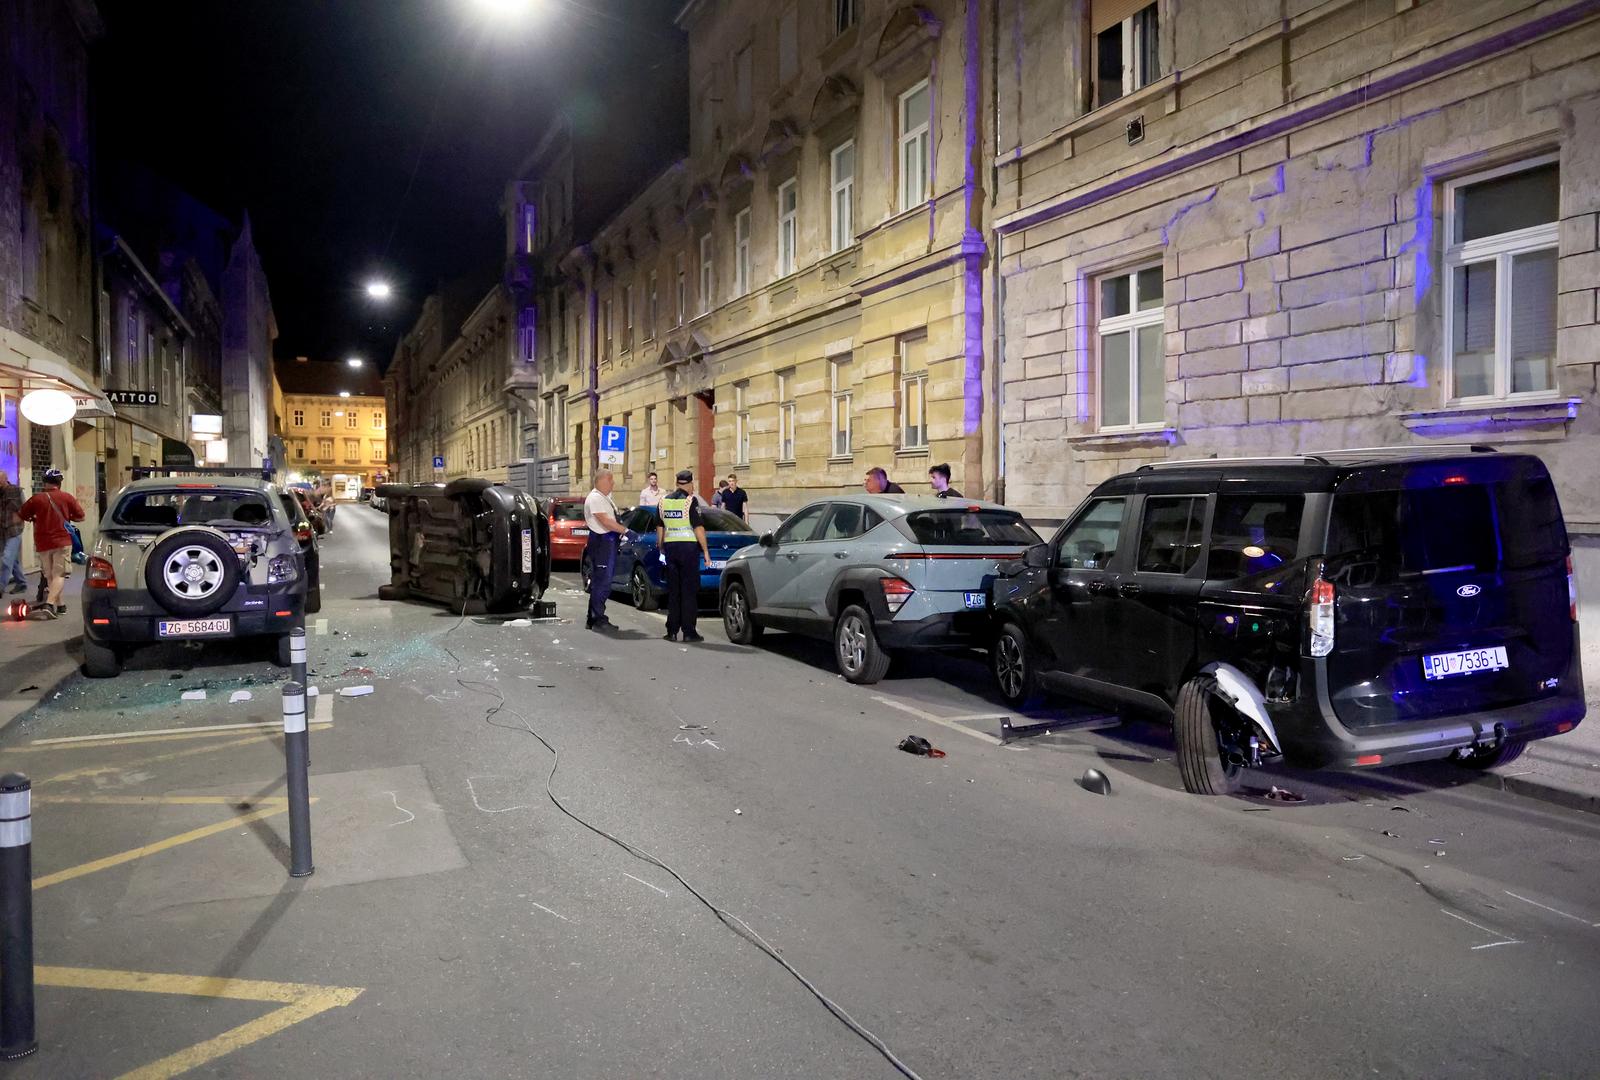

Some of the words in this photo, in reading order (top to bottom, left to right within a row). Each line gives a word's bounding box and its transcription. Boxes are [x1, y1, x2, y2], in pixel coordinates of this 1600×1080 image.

[607, 430, 619, 446] P
[971, 594, 981, 605] ZG
[168, 623, 181, 633] ZG
[1433, 656, 1450, 673] PU
